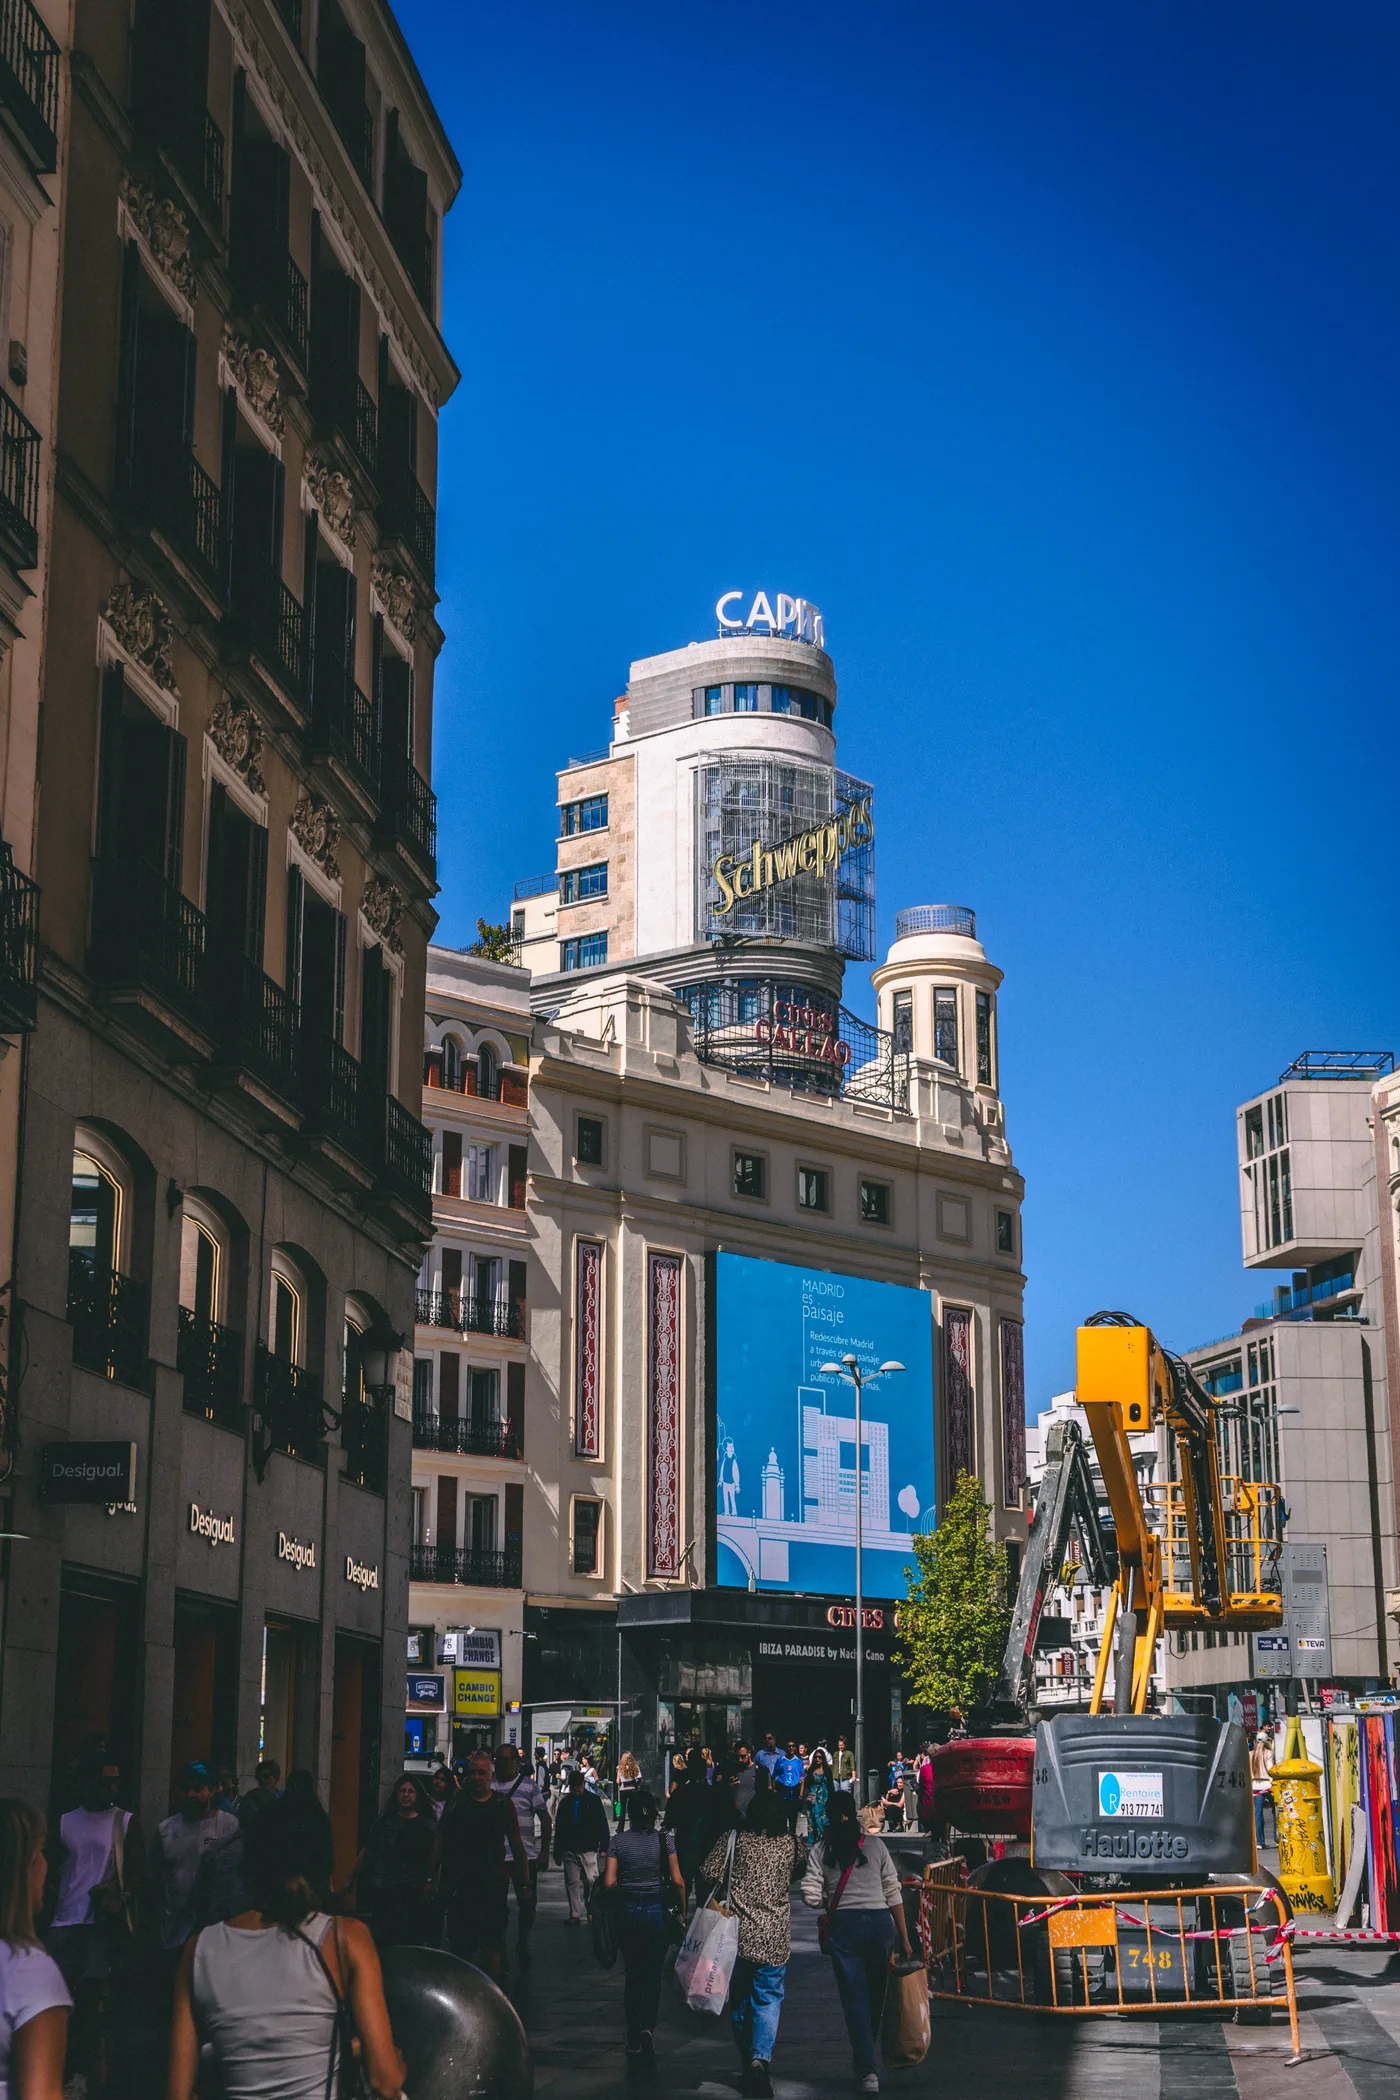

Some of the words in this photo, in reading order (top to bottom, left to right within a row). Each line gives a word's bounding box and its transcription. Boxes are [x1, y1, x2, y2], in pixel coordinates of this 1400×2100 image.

[713, 797, 874, 916] Schweppes
[773, 1000, 833, 1033] CINES
[755, 1019, 852, 1066] CALLAO
[802, 1279, 845, 1298] MADRID
[802, 1293, 813, 1304] es
[802, 1303, 844, 1327] paisaje
[810, 1331, 849, 1346] Redescubre
[850, 1337, 874, 1350] Madrid
[816, 1347, 836, 1357] través
[857, 1353, 880, 1365] paisaje
[810, 1373, 835, 1385] público
[52, 1462, 124, 1481] Desigual.
[190, 1503, 235, 1547] Desigual.
[278, 1532, 316, 1571] Desigual.
[346, 1556, 379, 1592] Desigual.
[827, 1605, 884, 1629] CINES
[759, 1642, 783, 1656] IBIZA
[784, 1644, 826, 1658] PARADISE
[827, 1646, 837, 1661] by
[839, 1648, 864, 1661] Nach
[865, 1650, 885, 1662] Cano
[1306, 1640, 1325, 1648] TEVA
[463, 1649, 495, 1663] CHANGE
[458, 1682, 495, 1692] CAMBIO
[457, 1693, 496, 1703] CHANGE
[1034, 1767, 1049, 1785] 48
[1216, 1770, 1247, 1789] 748
[1109, 1793, 1118, 1811] R
[1120, 1787, 1161, 1799] Rentaire
[1121, 1803, 1135, 1815] 913
[1136, 1804, 1149, 1816] 777
[1151, 1804, 1163, 1816] 741
[1080, 1828, 1189, 1859] Haulotte
[704, 1933, 726, 1995] primark.com
[1128, 1949, 1173, 1969] 748
